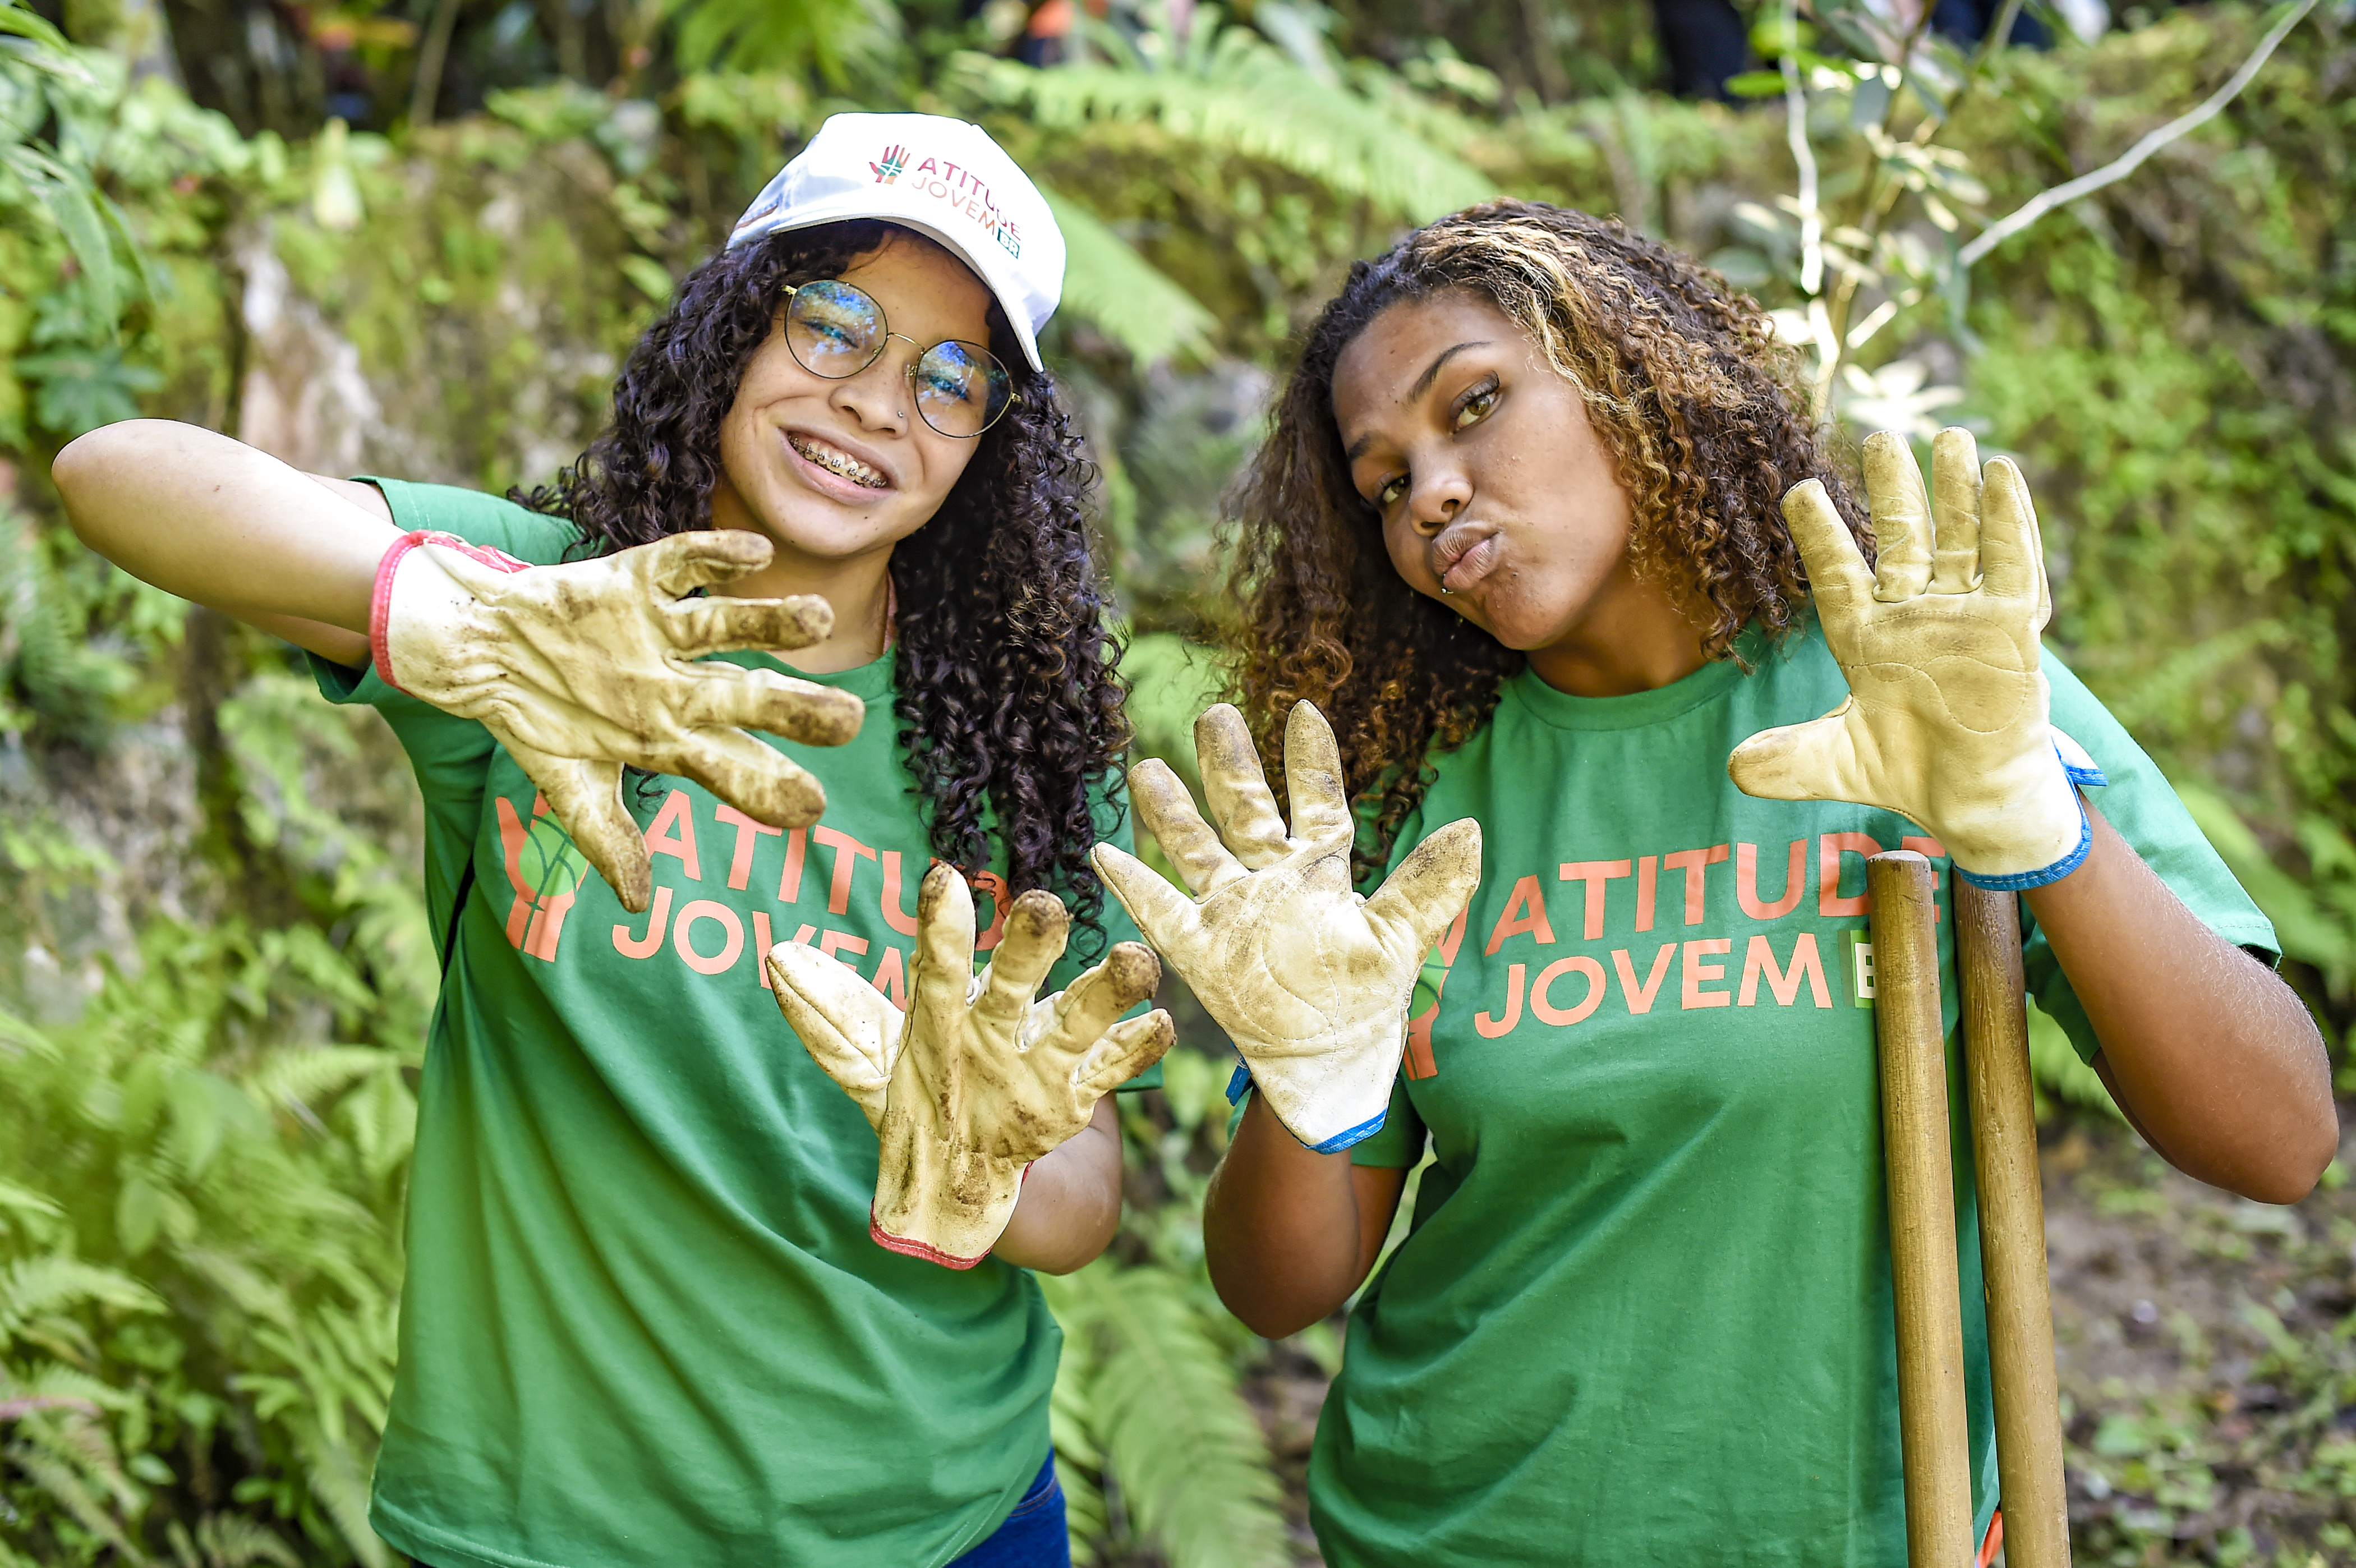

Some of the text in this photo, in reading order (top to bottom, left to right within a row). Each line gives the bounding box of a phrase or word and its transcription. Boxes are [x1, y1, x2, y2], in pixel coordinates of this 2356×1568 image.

[911, 177, 1020, 259] JOVEM BR
[917, 157, 1021, 241] ATITUDE
[1474, 932, 1833, 1039] JOVEM
